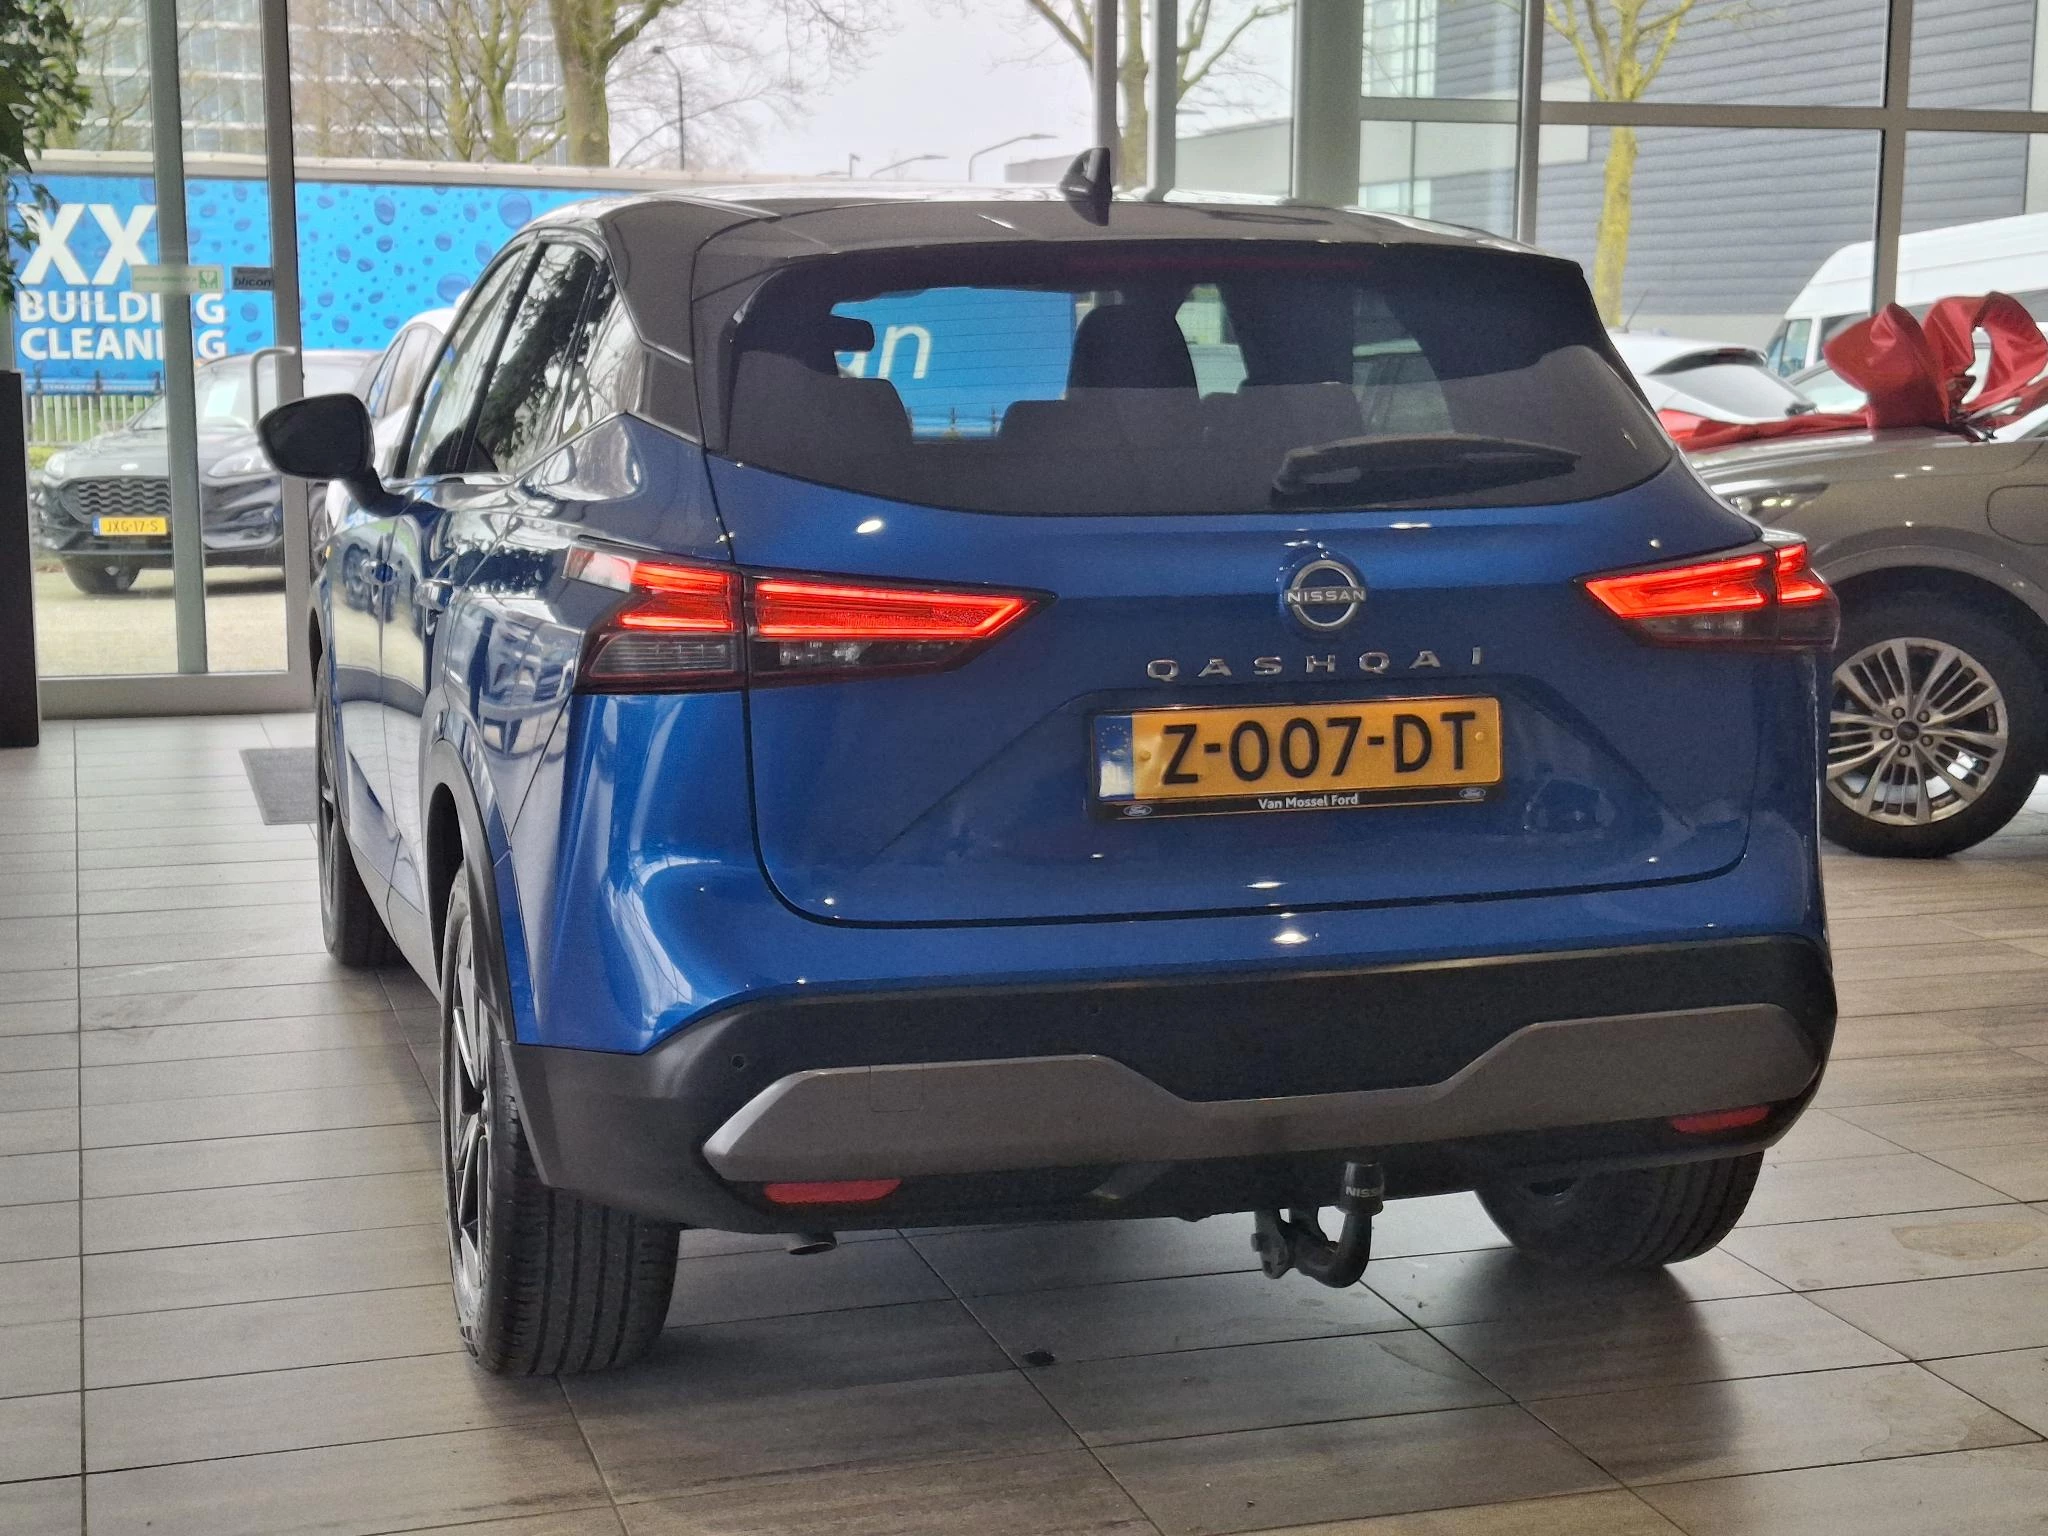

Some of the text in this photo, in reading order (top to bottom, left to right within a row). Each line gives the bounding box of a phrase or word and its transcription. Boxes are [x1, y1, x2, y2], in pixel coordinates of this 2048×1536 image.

[19, 290, 225, 324] BUILDIG
[20, 327, 228, 360] CLEANIG
[1287, 590, 1365, 602] NISSAN
[1147, 647, 1482, 682] QASHQAI
[1161, 711, 1476, 786] Z-007-DT
[1258, 793, 1359, 810] Van Mossel Ford
